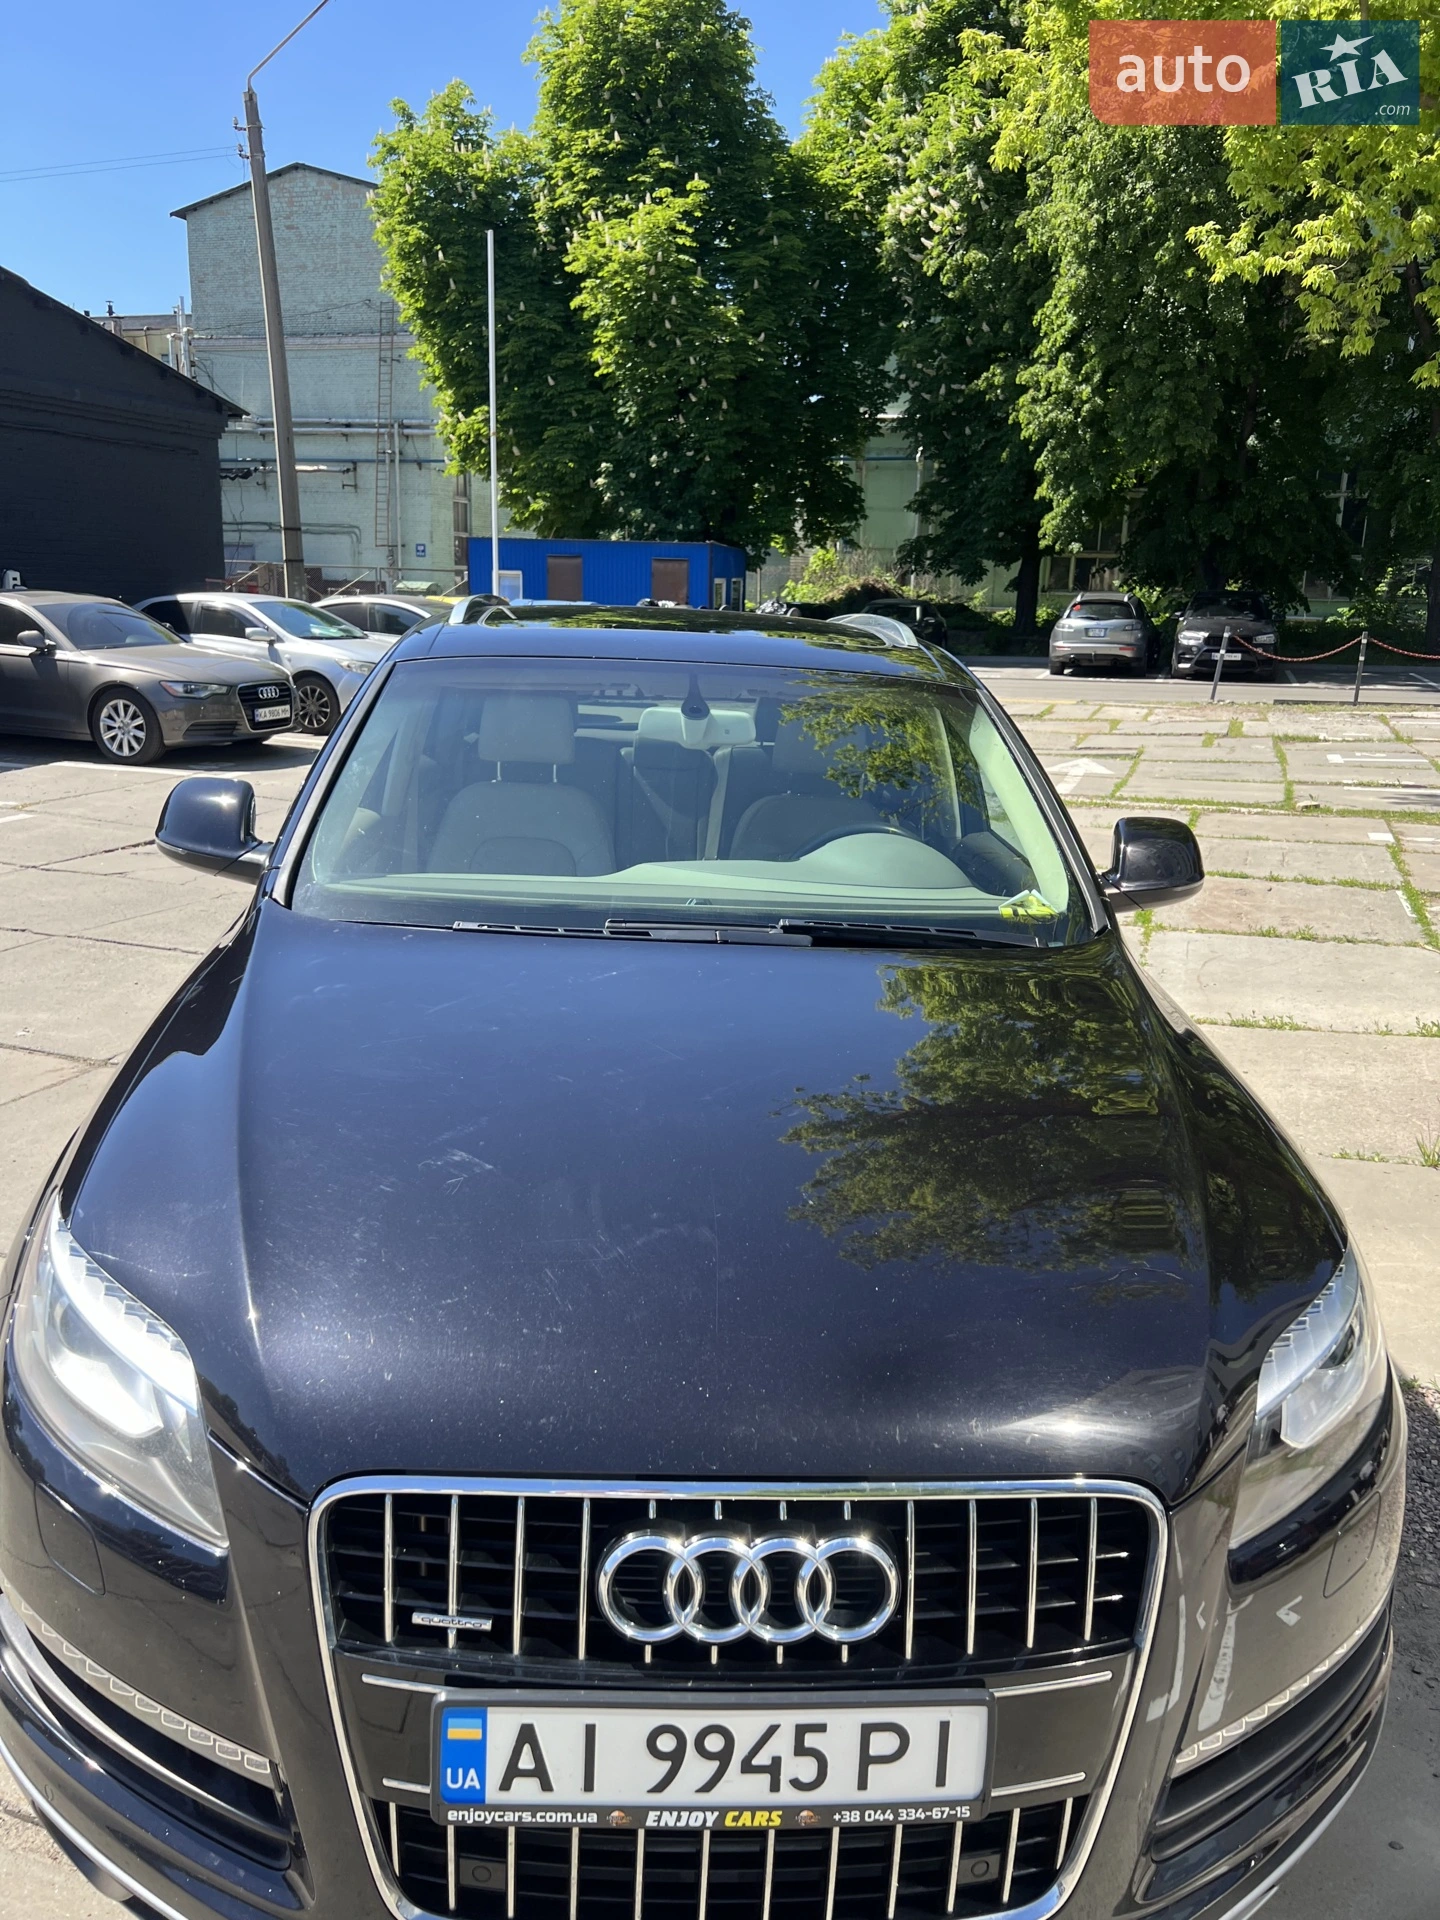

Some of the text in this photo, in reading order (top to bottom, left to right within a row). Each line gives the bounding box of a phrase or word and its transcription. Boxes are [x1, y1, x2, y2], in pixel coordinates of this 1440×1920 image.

[421, 1616, 483, 1629] quattro
[498, 1720, 951, 1793] AI 9945 PI
[446, 1768, 480, 1790] UA
[447, 1808, 598, 1824] enjoycars.com.ua
[645, 1810, 719, 1827] ENJOY
[724, 1810, 782, 1827] CARS
[833, 1810, 860, 1823] +38
[864, 1809, 894, 1822] 044
[898, 1806, 971, 1820] 334-67-15
